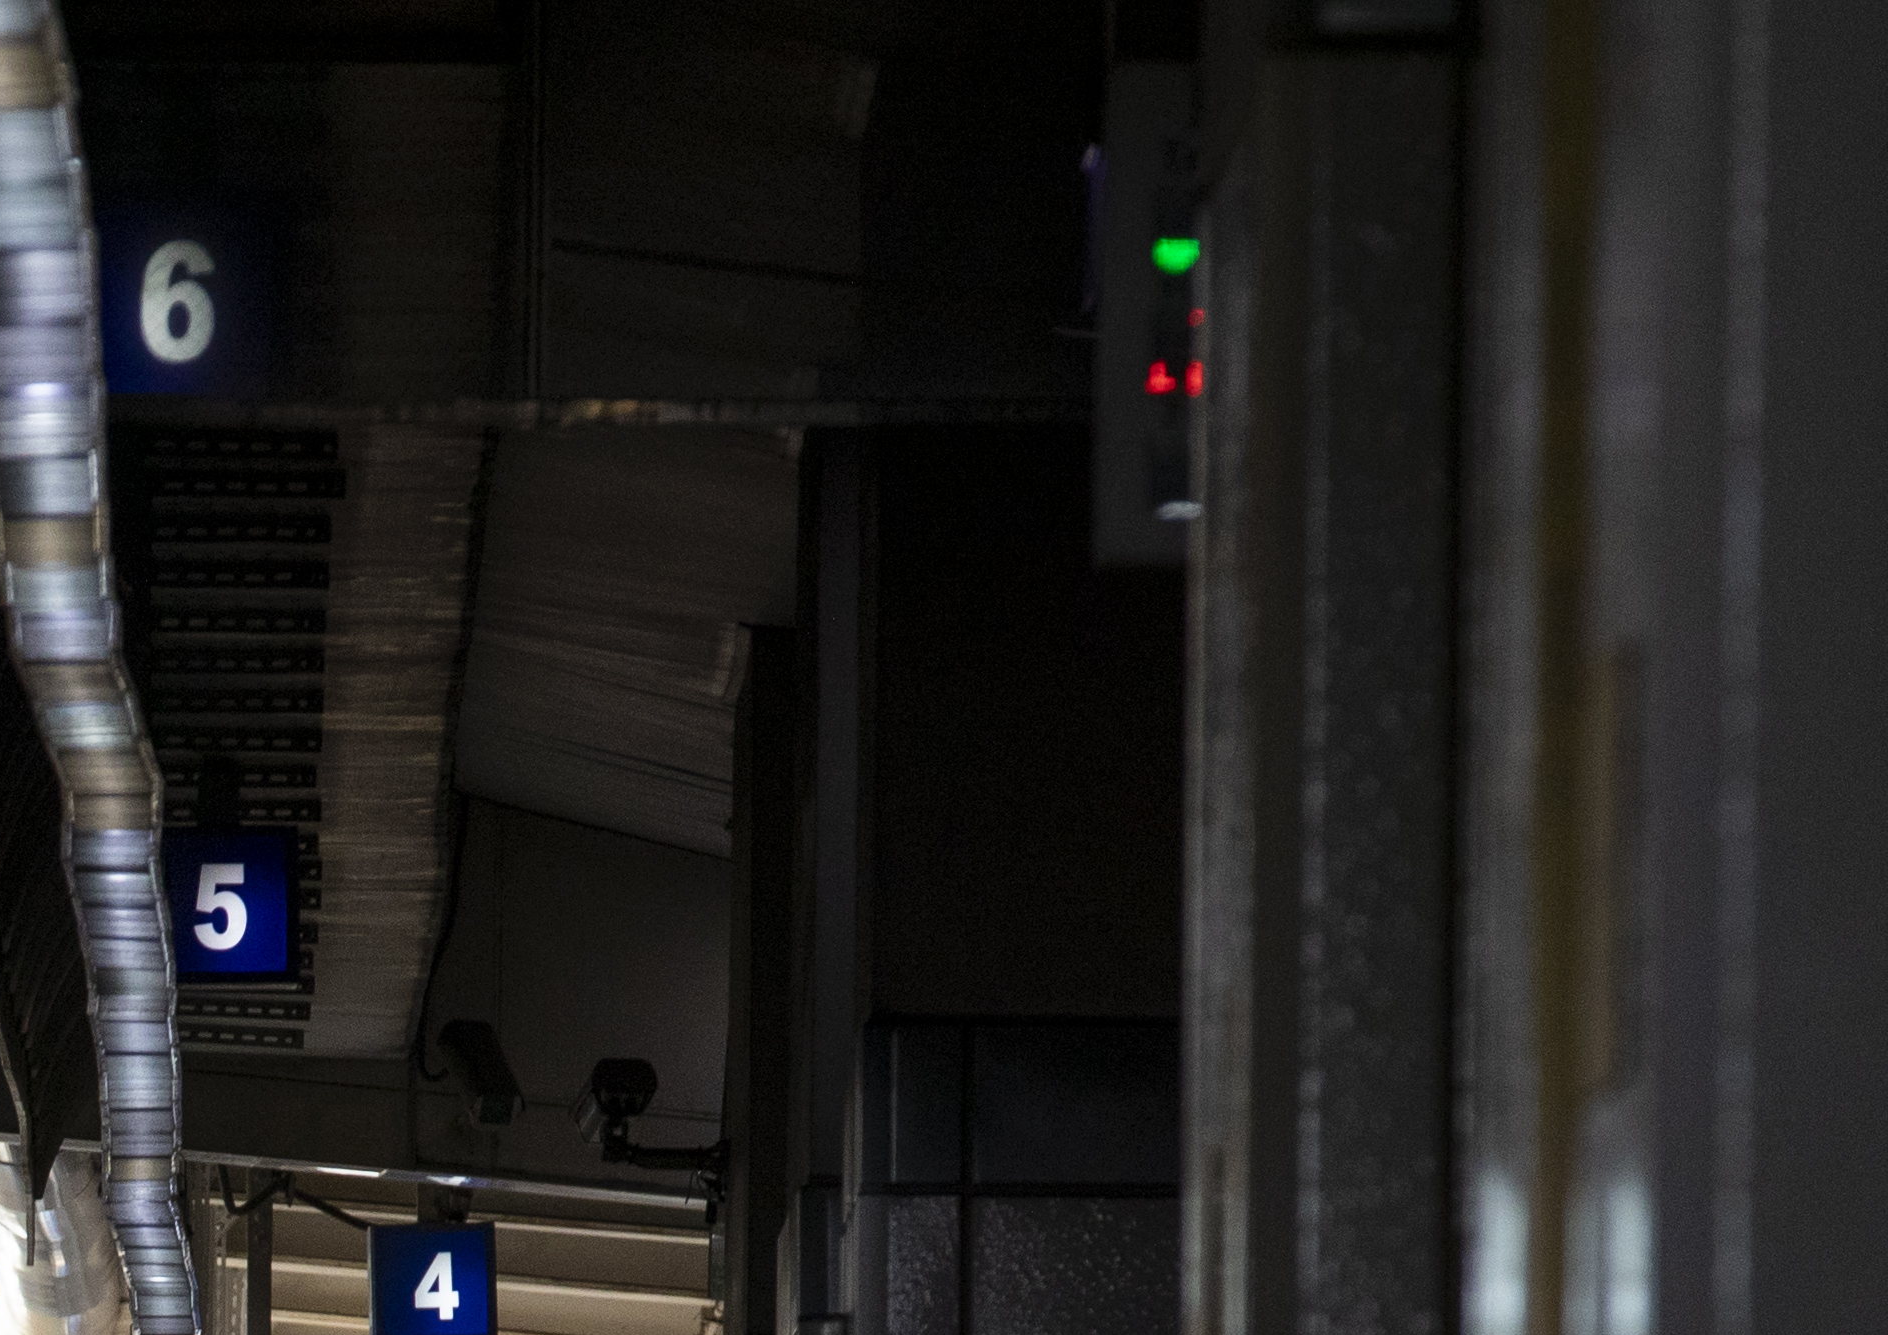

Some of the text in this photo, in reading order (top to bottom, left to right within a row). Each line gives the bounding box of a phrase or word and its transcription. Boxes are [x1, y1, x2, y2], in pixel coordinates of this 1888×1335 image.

[138, 239, 216, 363] 6
[193, 863, 247, 951] 5
[414, 1251, 459, 1320] 4
